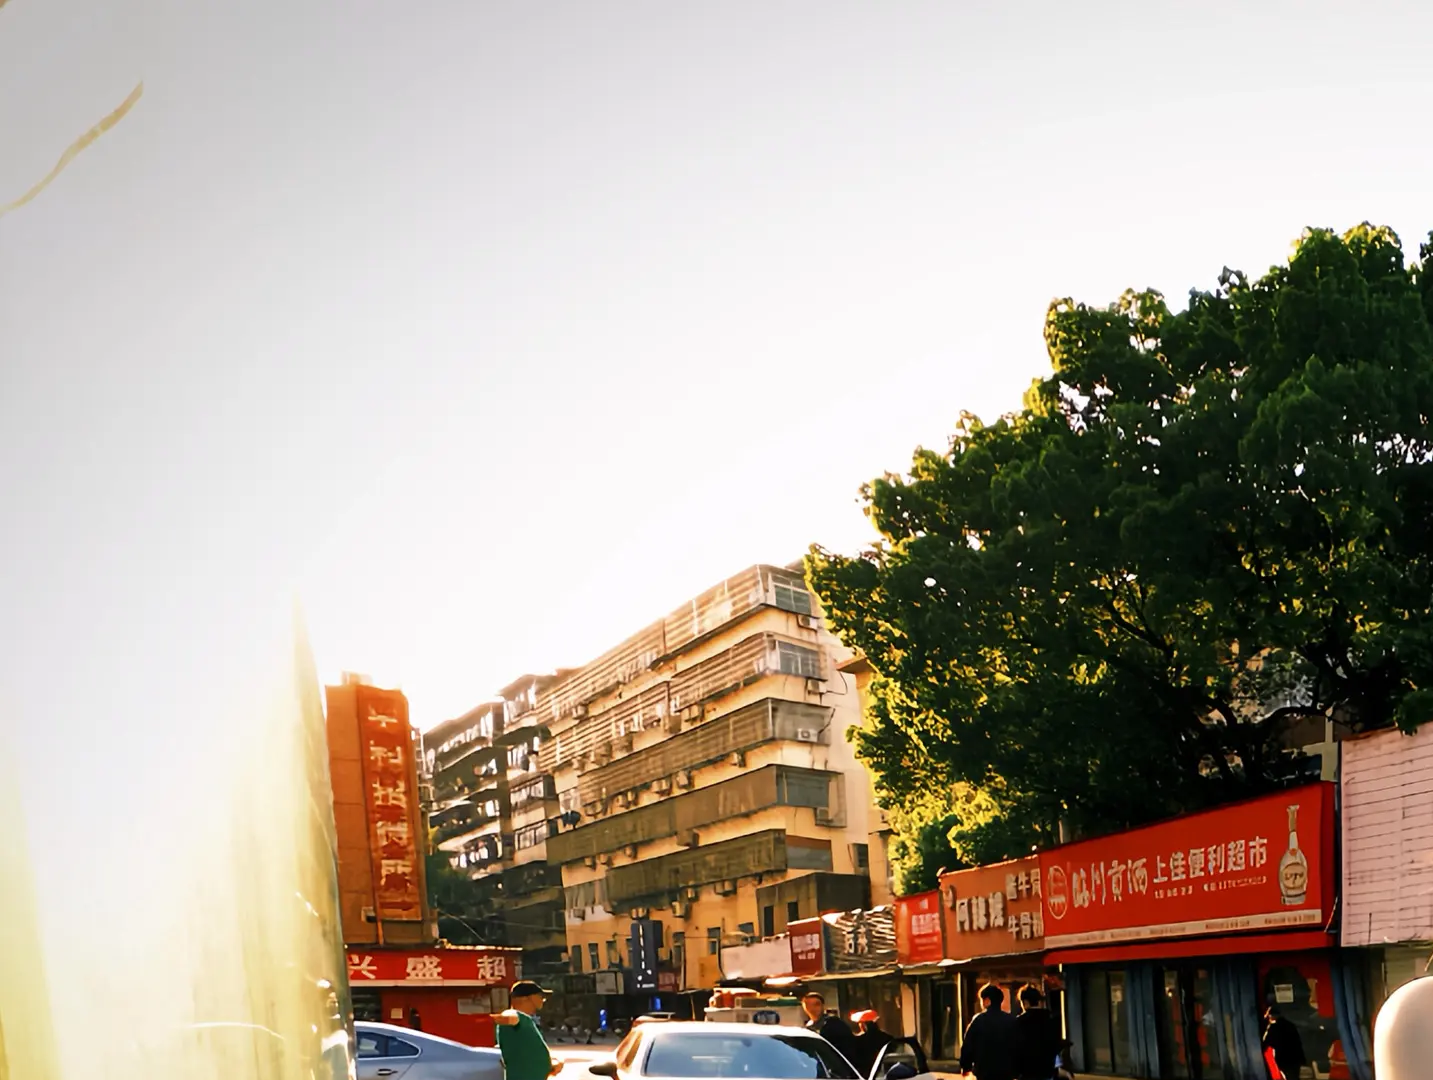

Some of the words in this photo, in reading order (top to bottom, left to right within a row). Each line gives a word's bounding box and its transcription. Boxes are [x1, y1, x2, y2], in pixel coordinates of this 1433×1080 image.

[1152, 835, 1269, 884] 上佳便利超市
